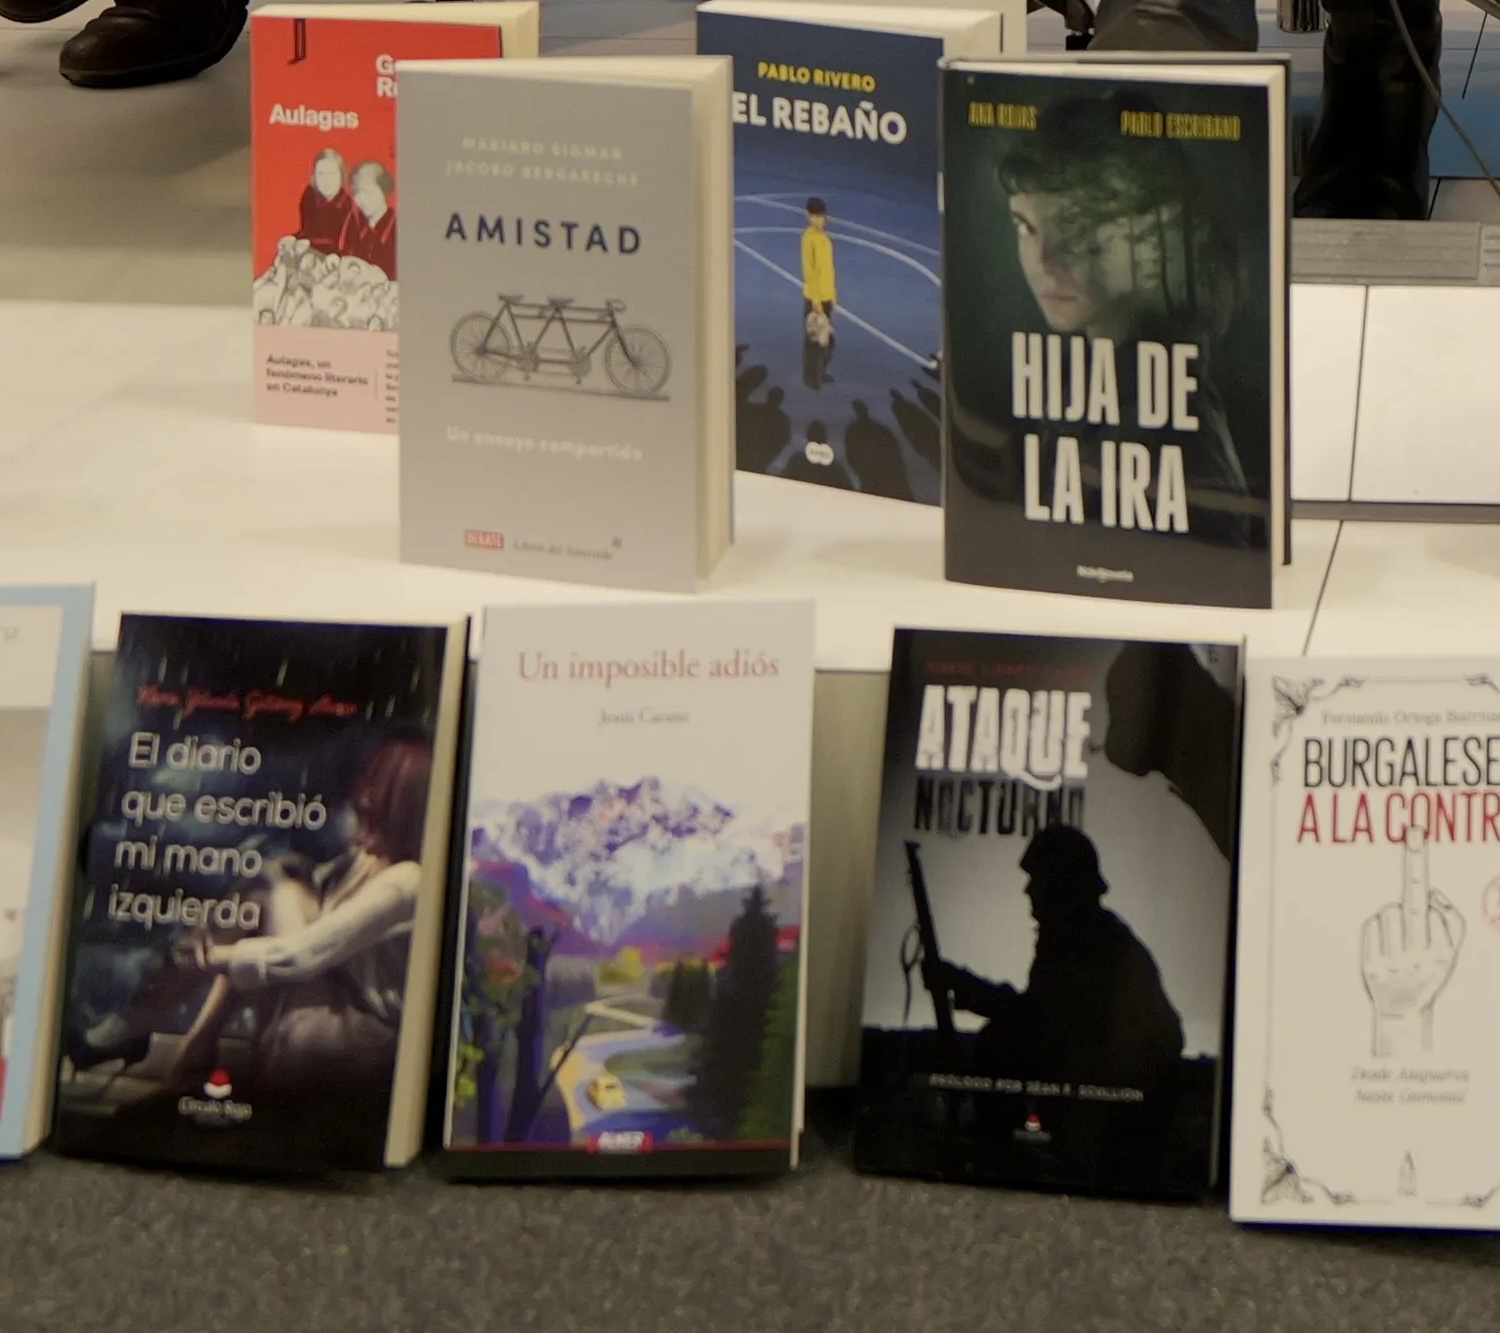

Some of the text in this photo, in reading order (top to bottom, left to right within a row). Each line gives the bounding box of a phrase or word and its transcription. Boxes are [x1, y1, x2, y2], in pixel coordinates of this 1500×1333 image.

[757, 61, 876, 93] PABLO RIVERO
[269, 103, 360, 133] Aulagas
[732, 91, 907, 145] EL REBAÑO
[444, 211, 641, 255] AMISTAD
[1011, 331, 1200, 432] HIJA DE
[1023, 432, 1190, 534] LA IRA
[517, 647, 782, 689] Un imposible adiós
[128, 731, 263, 776] El diario
[914, 683, 1093, 792] ATAQUE
[120, 789, 328, 832] que escribió
[1296, 791, 1321, 844] A
[1331, 791, 1375, 844] LA
[113, 834, 264, 879] mi mano
[106, 883, 263, 931] izquierda
